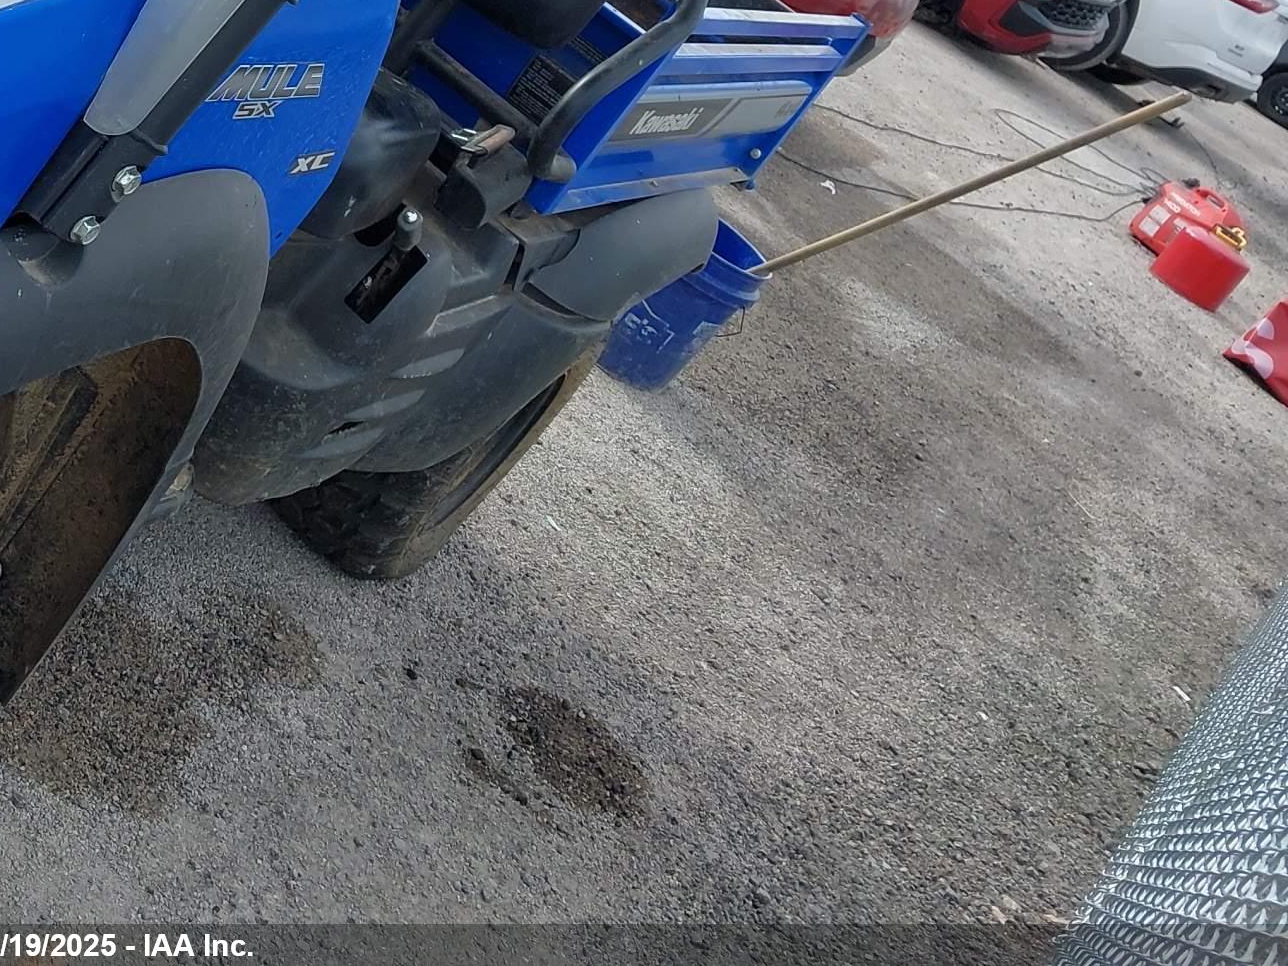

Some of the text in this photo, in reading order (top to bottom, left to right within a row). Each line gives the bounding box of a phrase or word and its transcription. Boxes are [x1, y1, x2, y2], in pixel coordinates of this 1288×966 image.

[205, 63, 324, 102] MULE
[232, 100, 283, 119] SX
[629, 107, 704, 134] Kawasaki
[290, 152, 335, 174] XC
